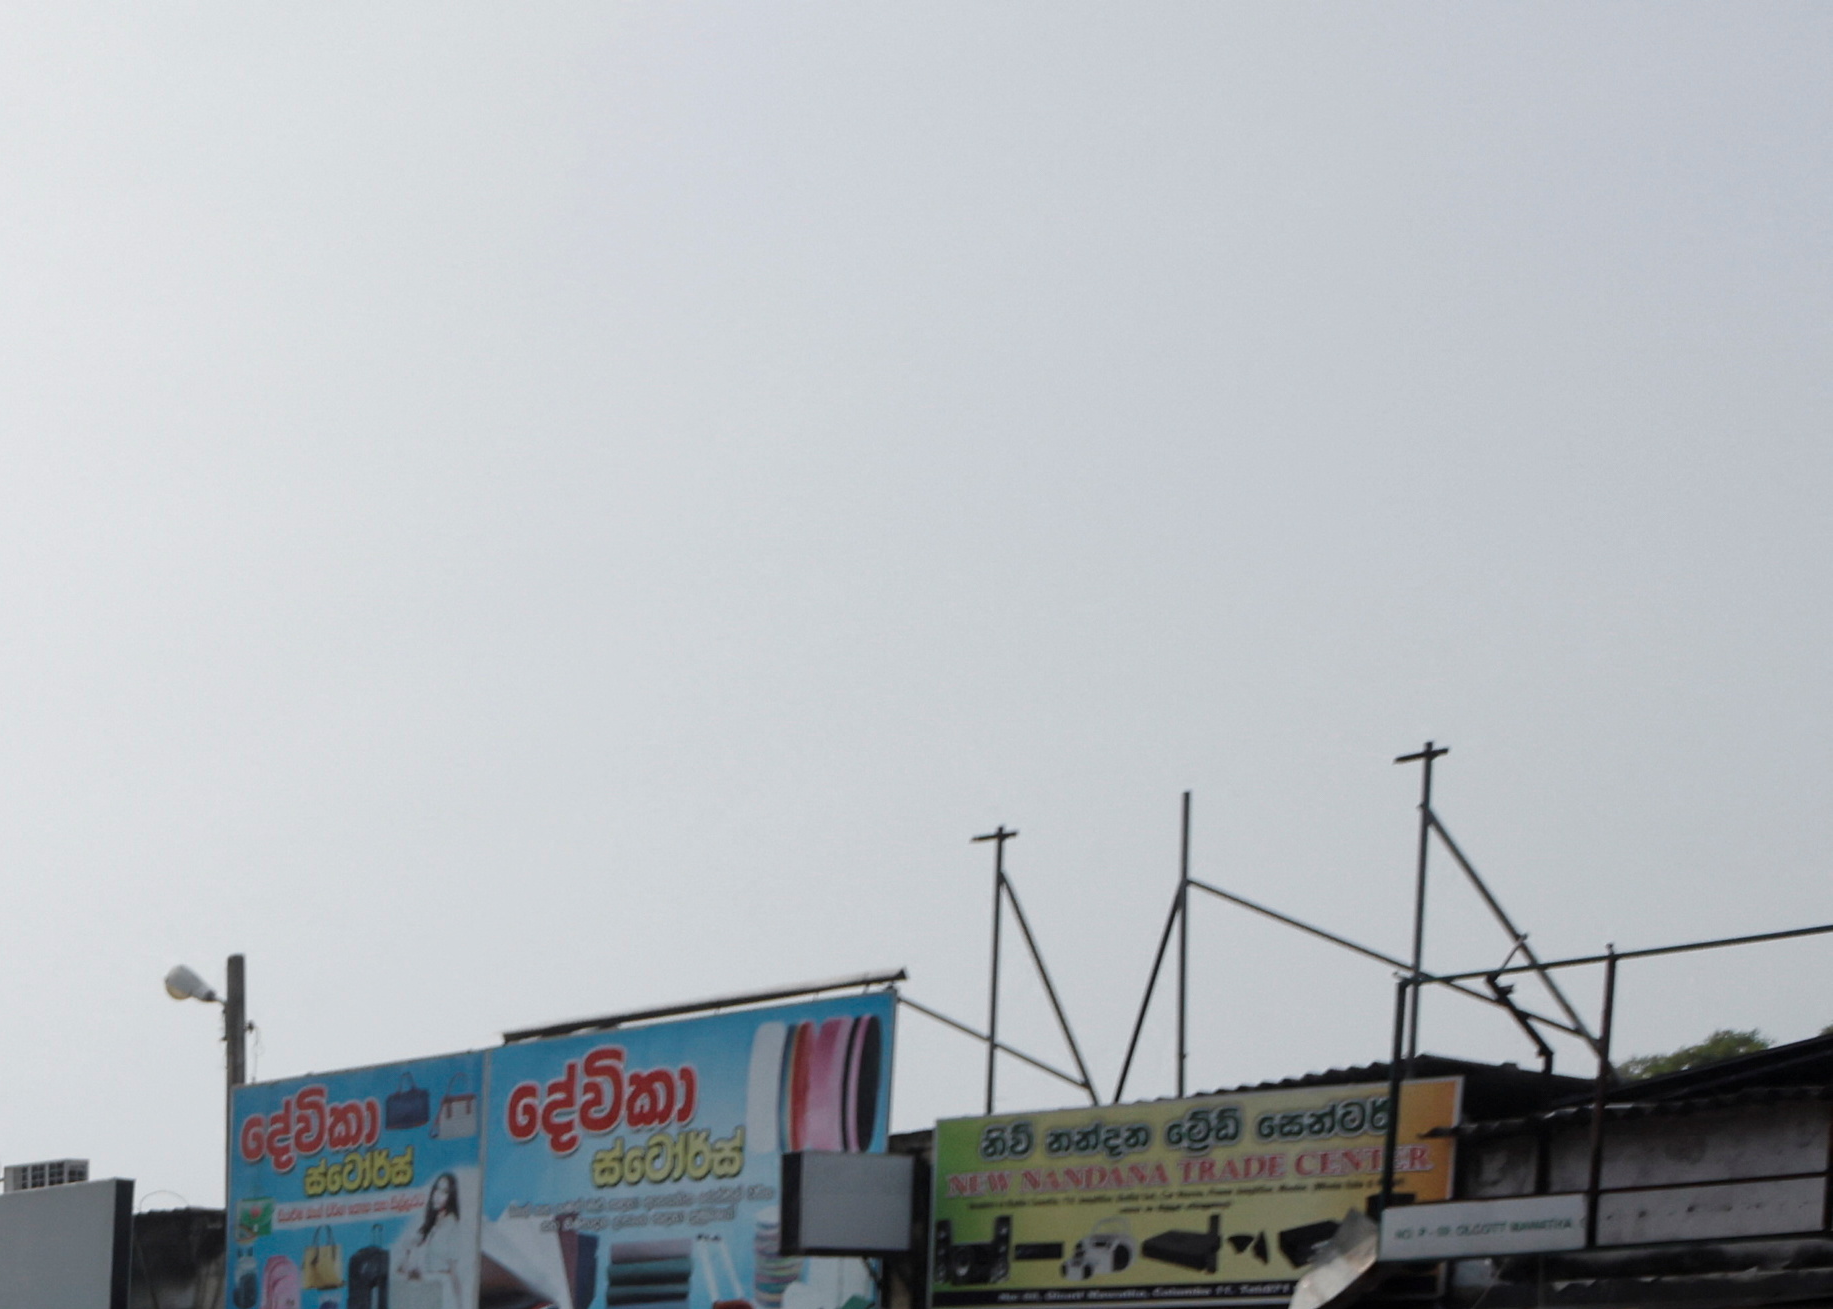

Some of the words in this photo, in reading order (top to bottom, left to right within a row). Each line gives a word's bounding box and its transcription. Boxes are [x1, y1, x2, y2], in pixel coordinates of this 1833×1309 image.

[240, 1084, 380, 1173] දේවිකා
[508, 1045, 697, 1157] දේවිකා
[947, 1172, 1011, 1197] NEW
[1020, 1161, 1171, 1193] NANDANA
[1177, 1154, 1287, 1187] TRADE
